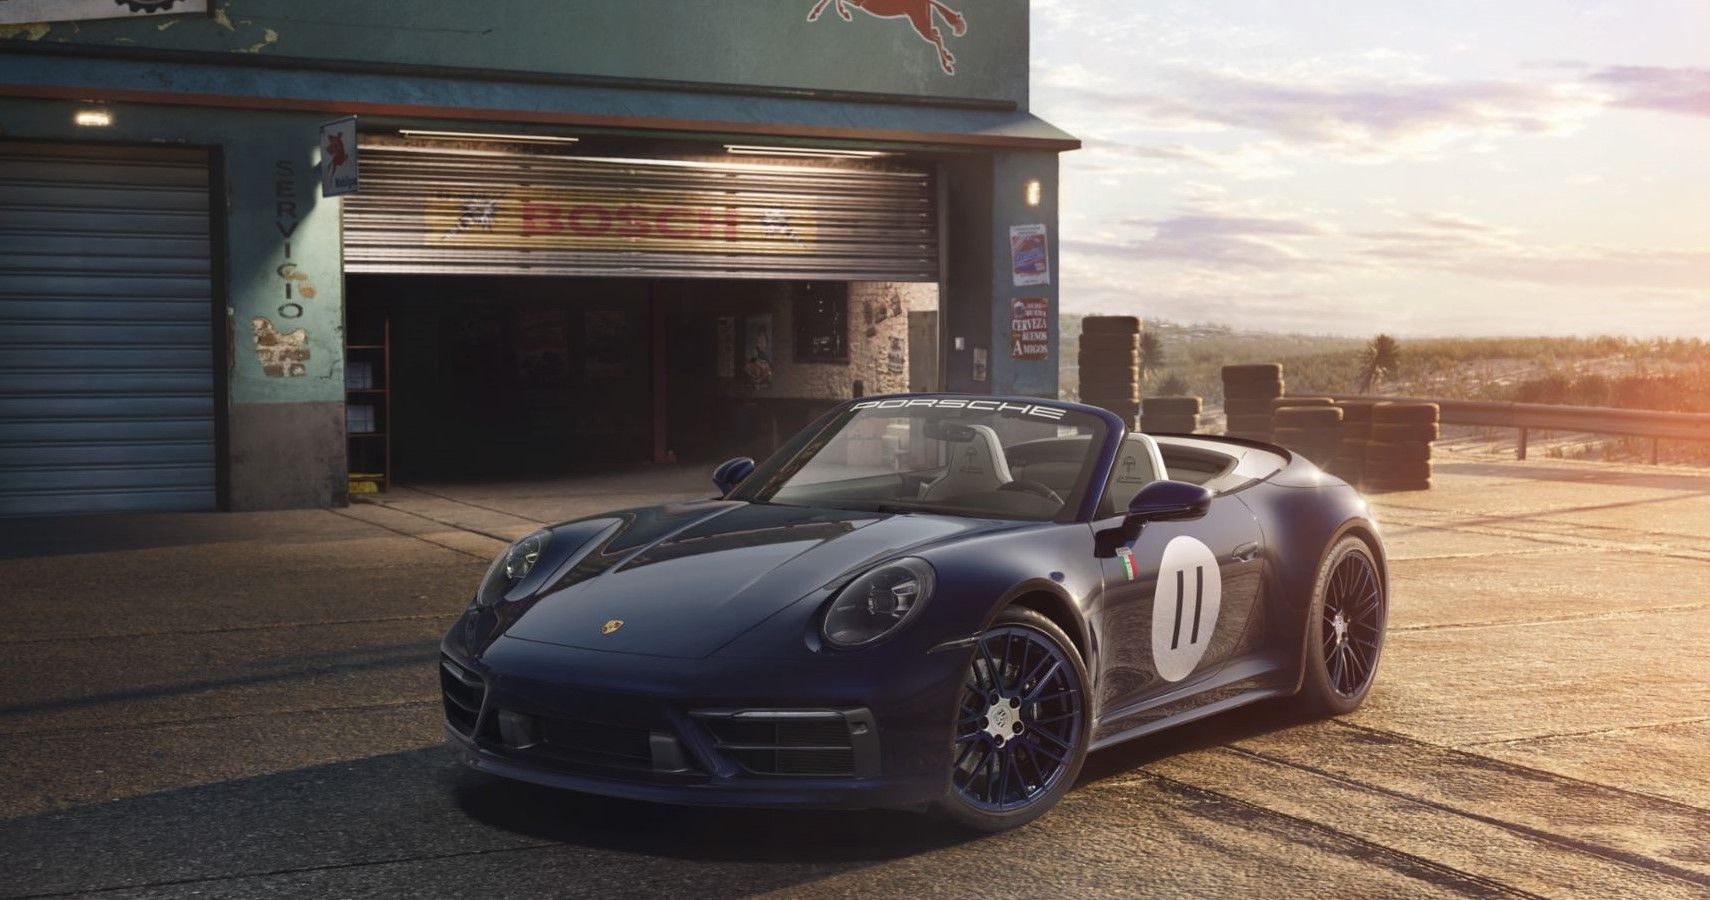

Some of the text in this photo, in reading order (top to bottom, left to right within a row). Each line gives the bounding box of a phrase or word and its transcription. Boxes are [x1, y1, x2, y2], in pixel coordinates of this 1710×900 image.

[275, 160, 304, 319] SERVICIO
[521, 201, 738, 242] BOSCH
[1012, 318, 1047, 331] CERVEZA
[850, 399, 1067, 420] PORSCHE
[1171, 566, 1203, 650] 11
